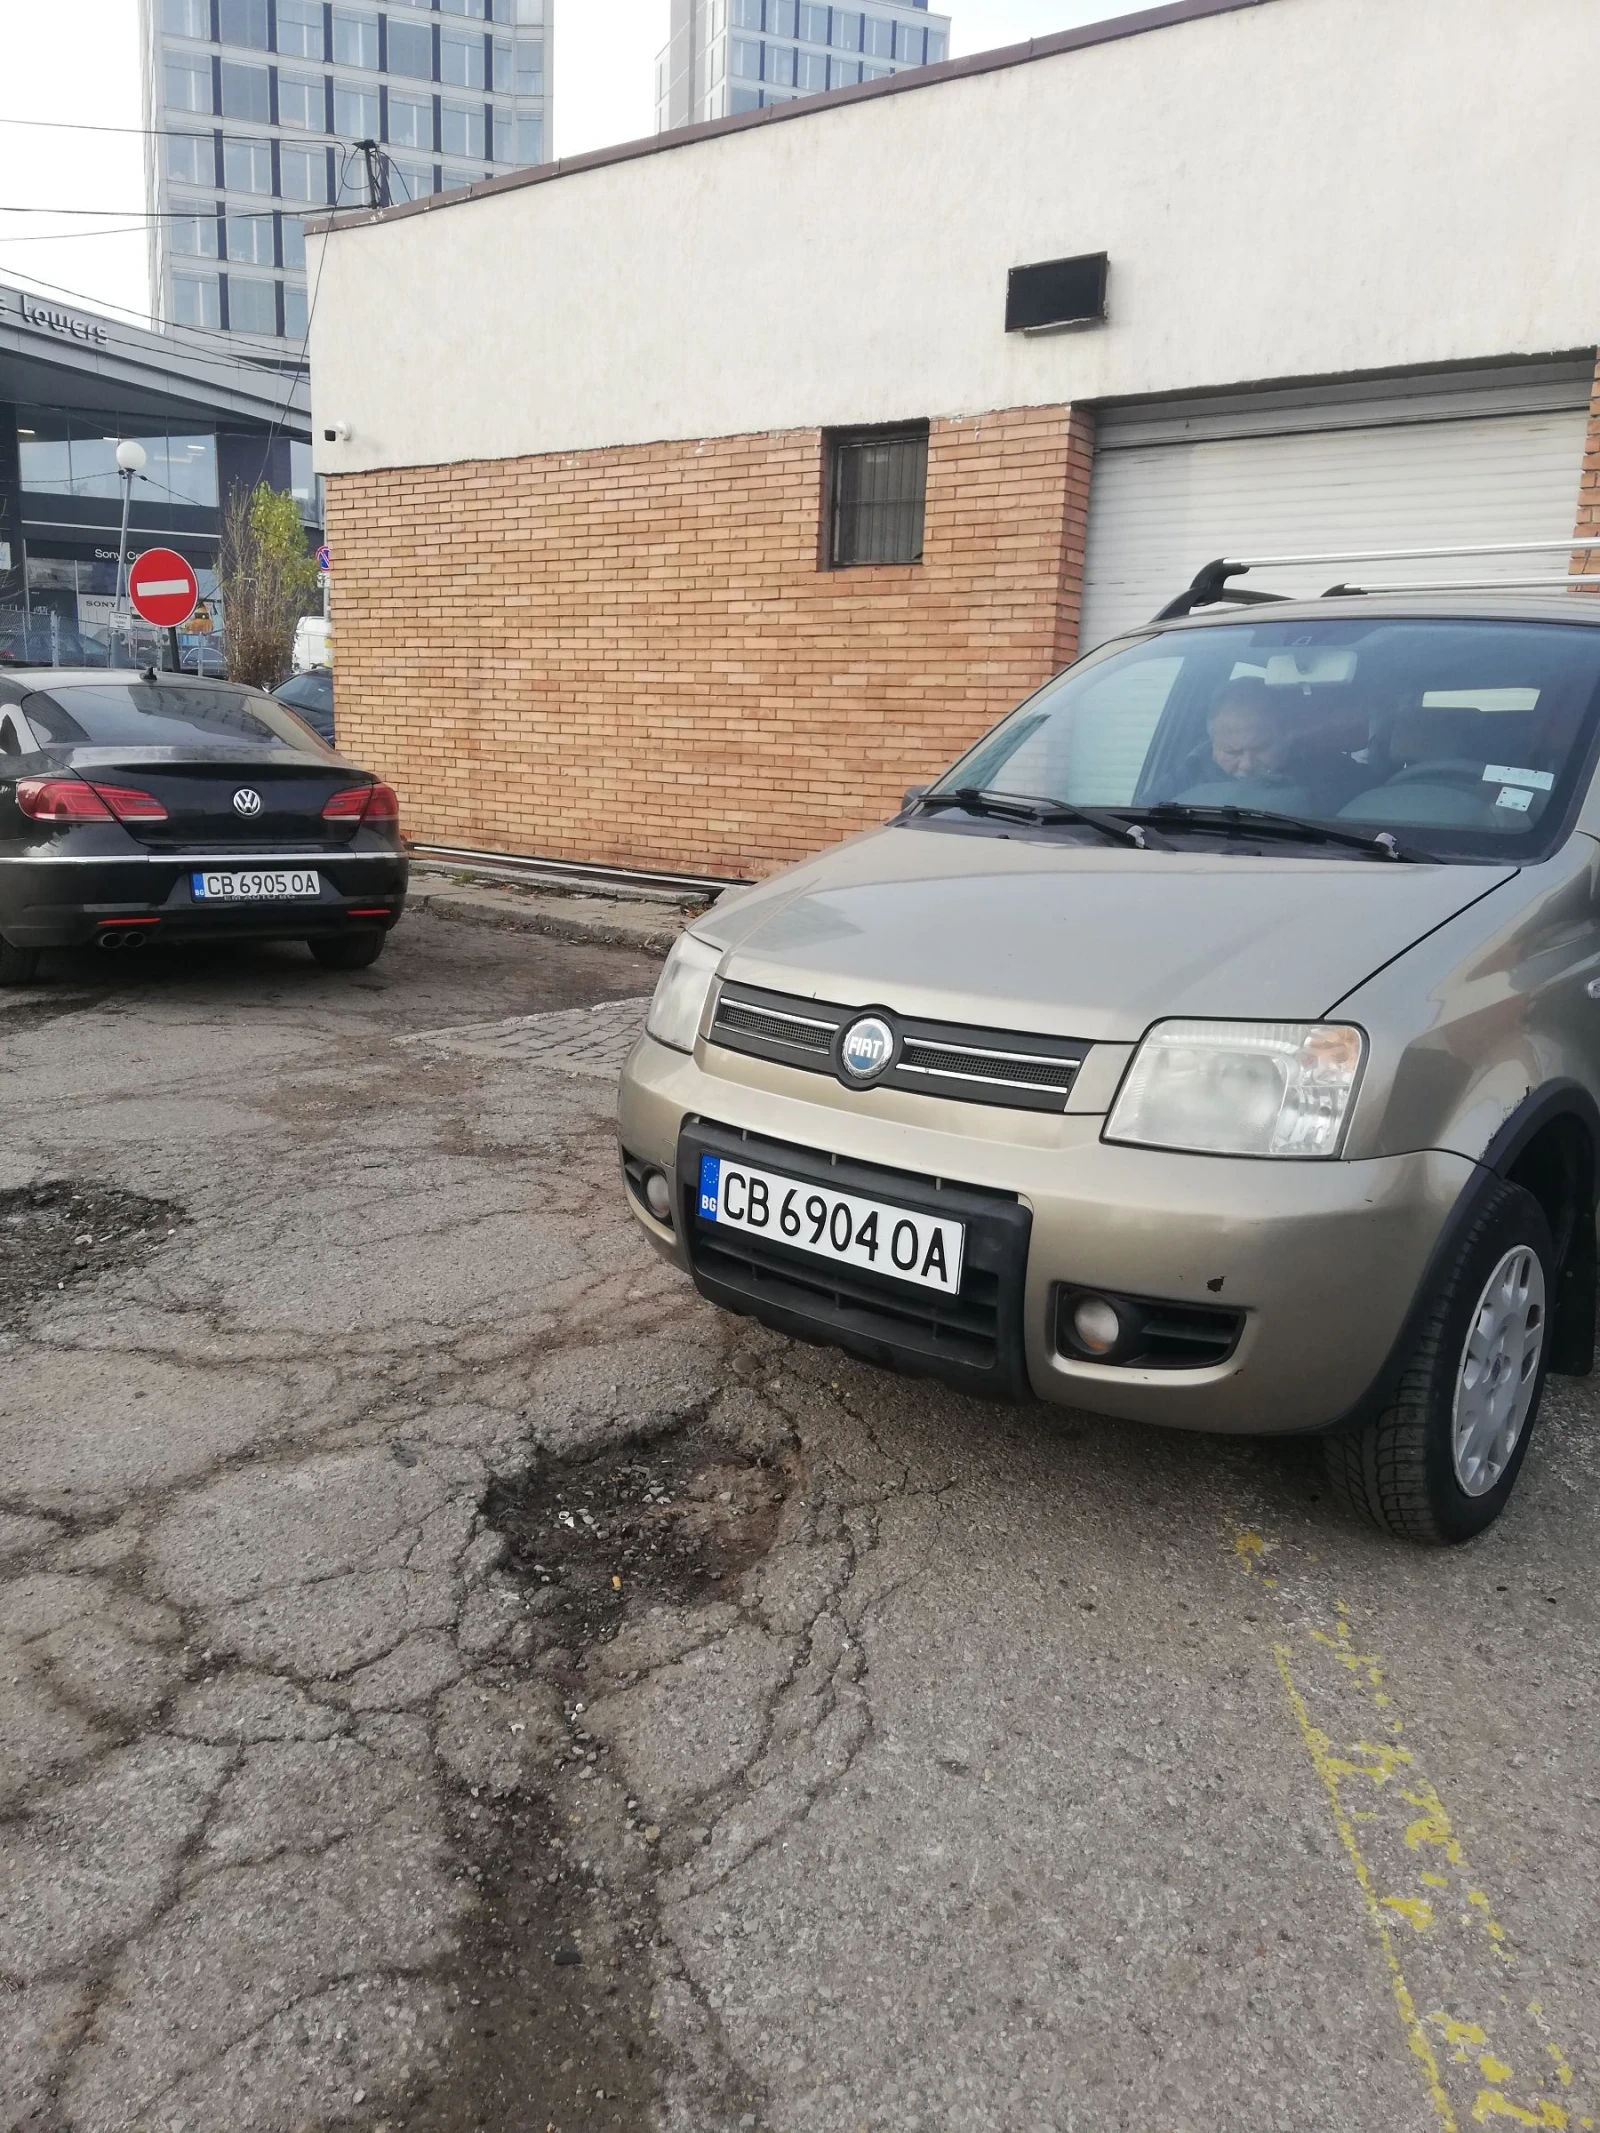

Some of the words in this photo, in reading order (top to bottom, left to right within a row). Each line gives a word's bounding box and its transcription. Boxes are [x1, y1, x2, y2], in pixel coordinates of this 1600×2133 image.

[20, 294, 109, 345] towers
[95, 549, 120, 561] Sony
[127, 551, 141, 560] Ce
[207, 875, 234, 895] CB
[239, 874, 287, 894] 6905
[847, 1035, 884, 1060] FIAT
[700, 1193, 718, 1212] BG
[723, 1171, 770, 1227] CB
[779, 1188, 879, 1262] 6904
[891, 1218, 948, 1283] OA
